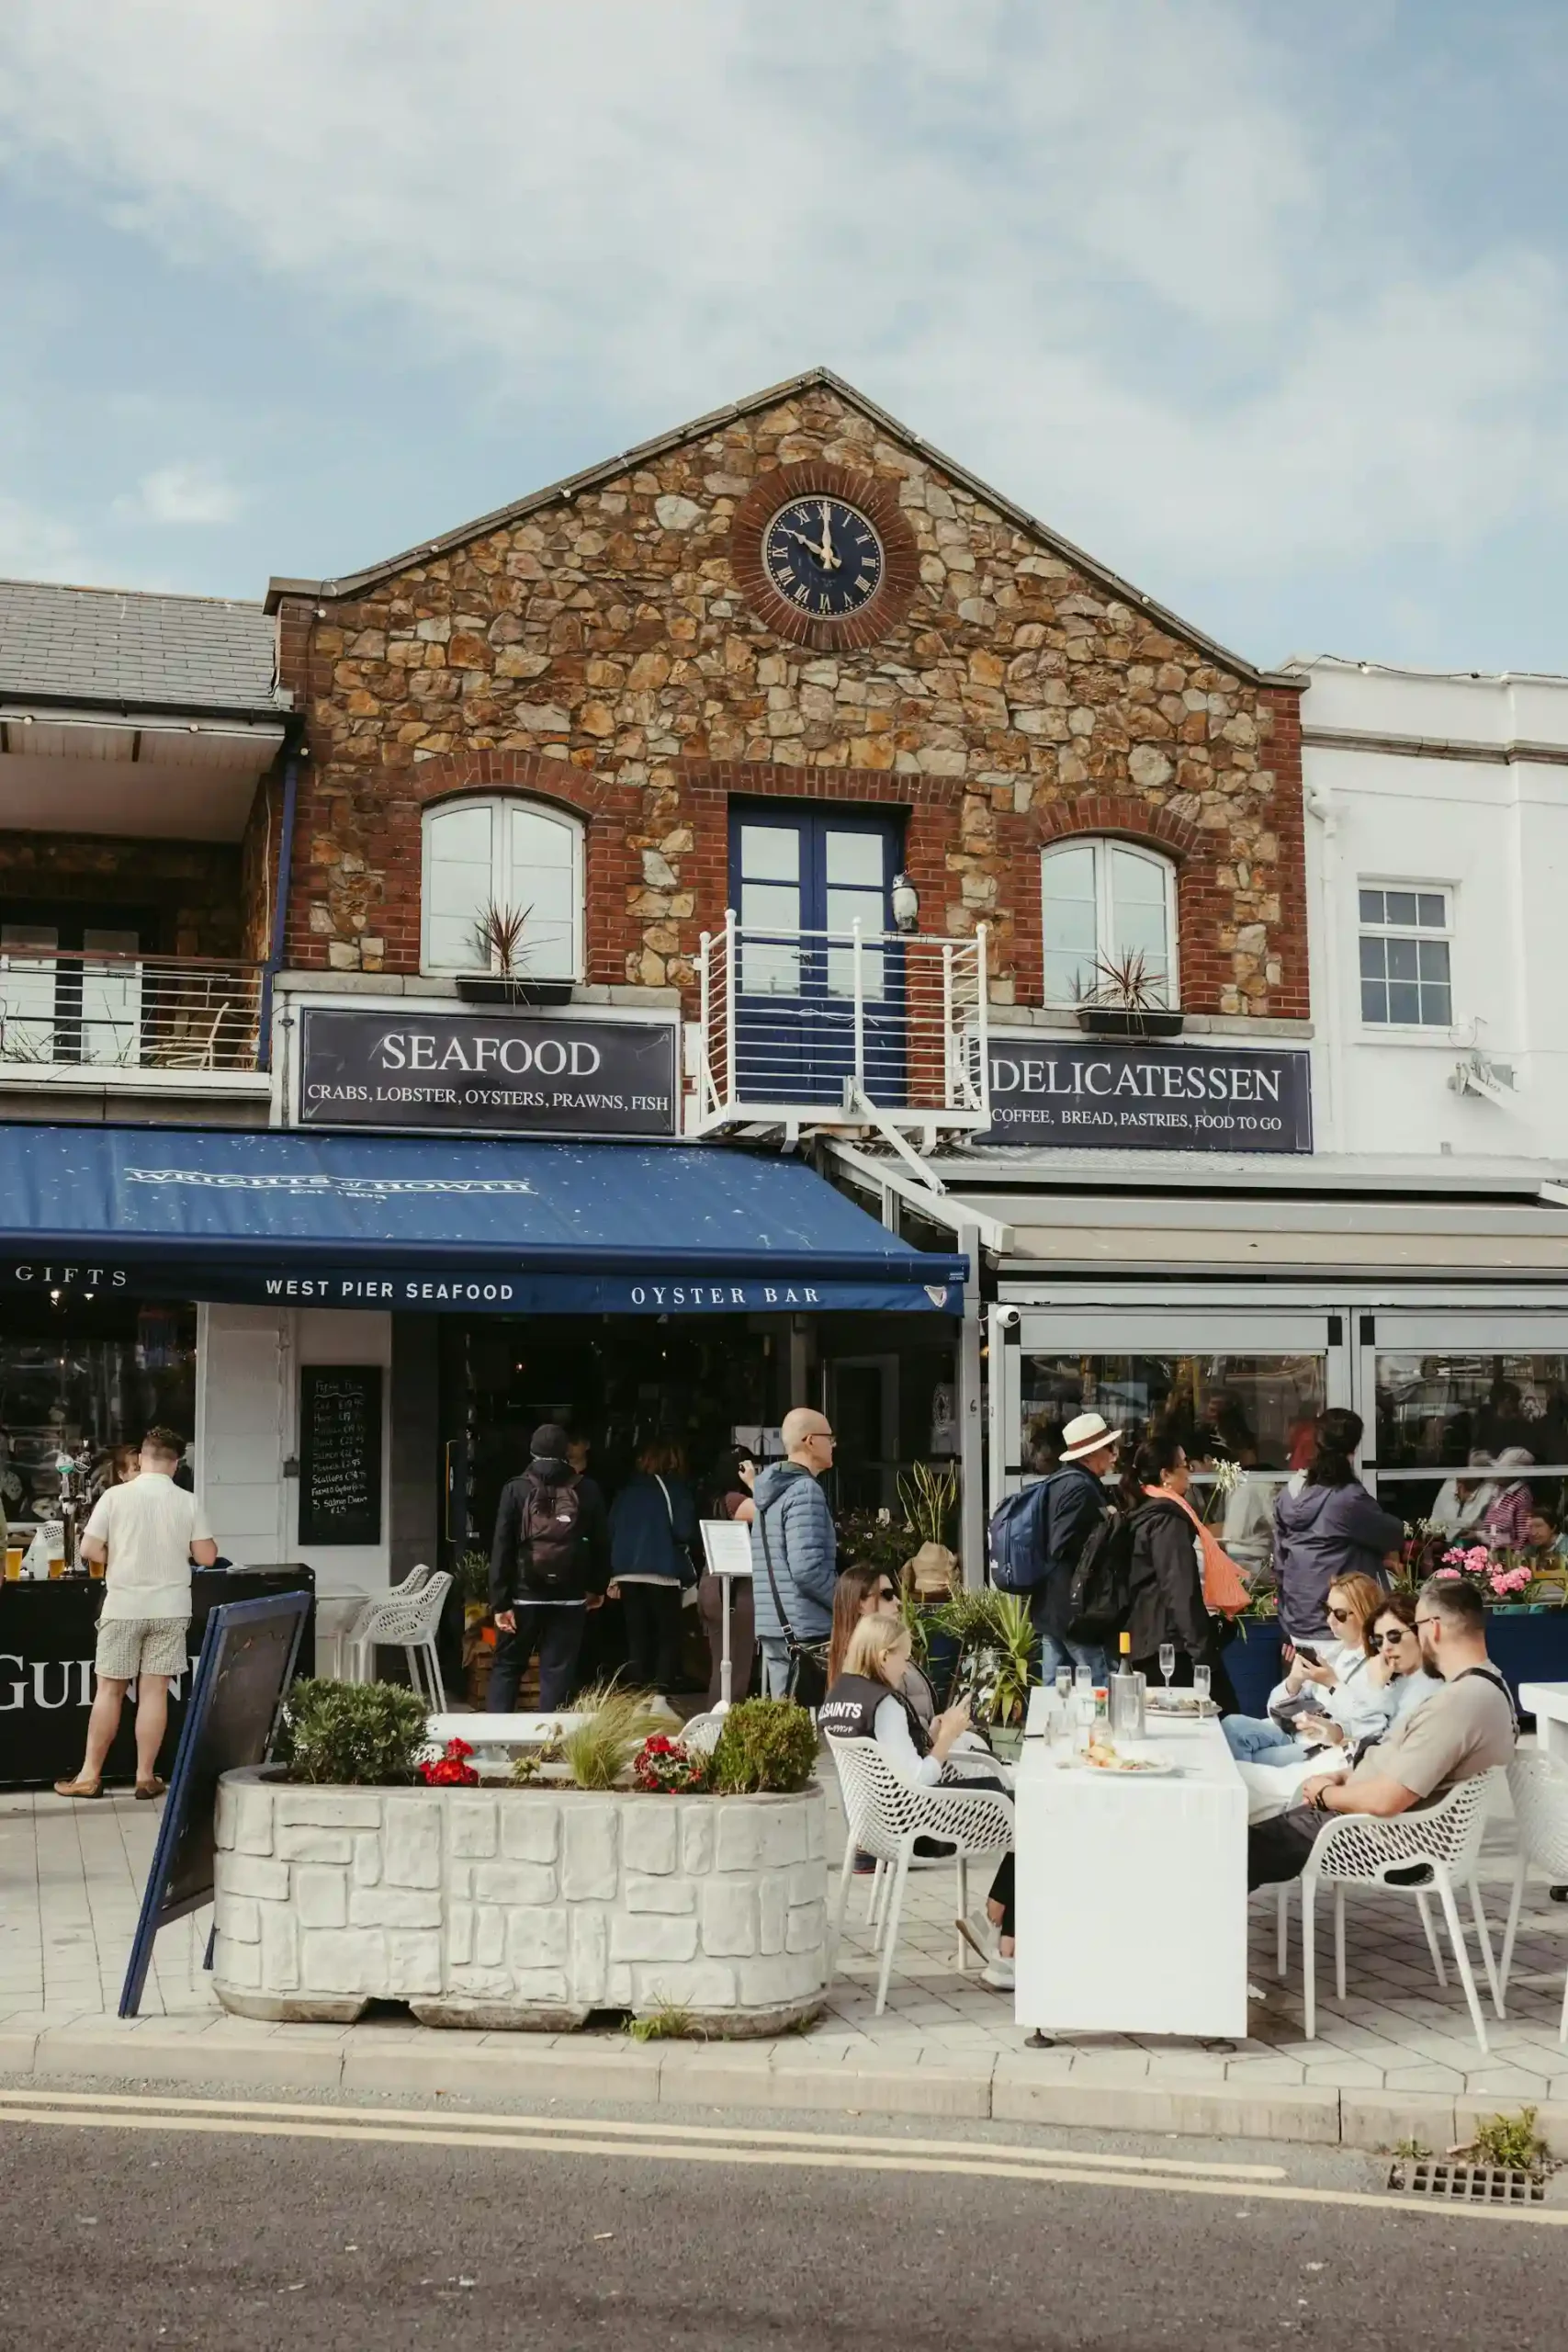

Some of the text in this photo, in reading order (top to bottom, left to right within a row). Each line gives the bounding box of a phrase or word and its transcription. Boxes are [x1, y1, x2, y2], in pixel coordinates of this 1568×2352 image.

[382, 1035, 601, 1076] SEAFOOD
[989, 1059, 1282, 1102] DELICATESSEN
[308, 1084, 670, 1112] CRABS, LOBSTER, OYSTERS, PRAWNS, FISH
[991, 1108, 1282, 1131] COFFEE, BREAD, PASTRIES, FOOD TO GO
[130, 1170, 331, 1186] WRIGHTS
[371, 1182, 530, 1192] HOWTH
[15, 1265, 127, 1286] GIFTS
[265, 1280, 514, 1301] WEST PIER SEAFOOD
[631, 1286, 820, 1305] OYSTER BAR
